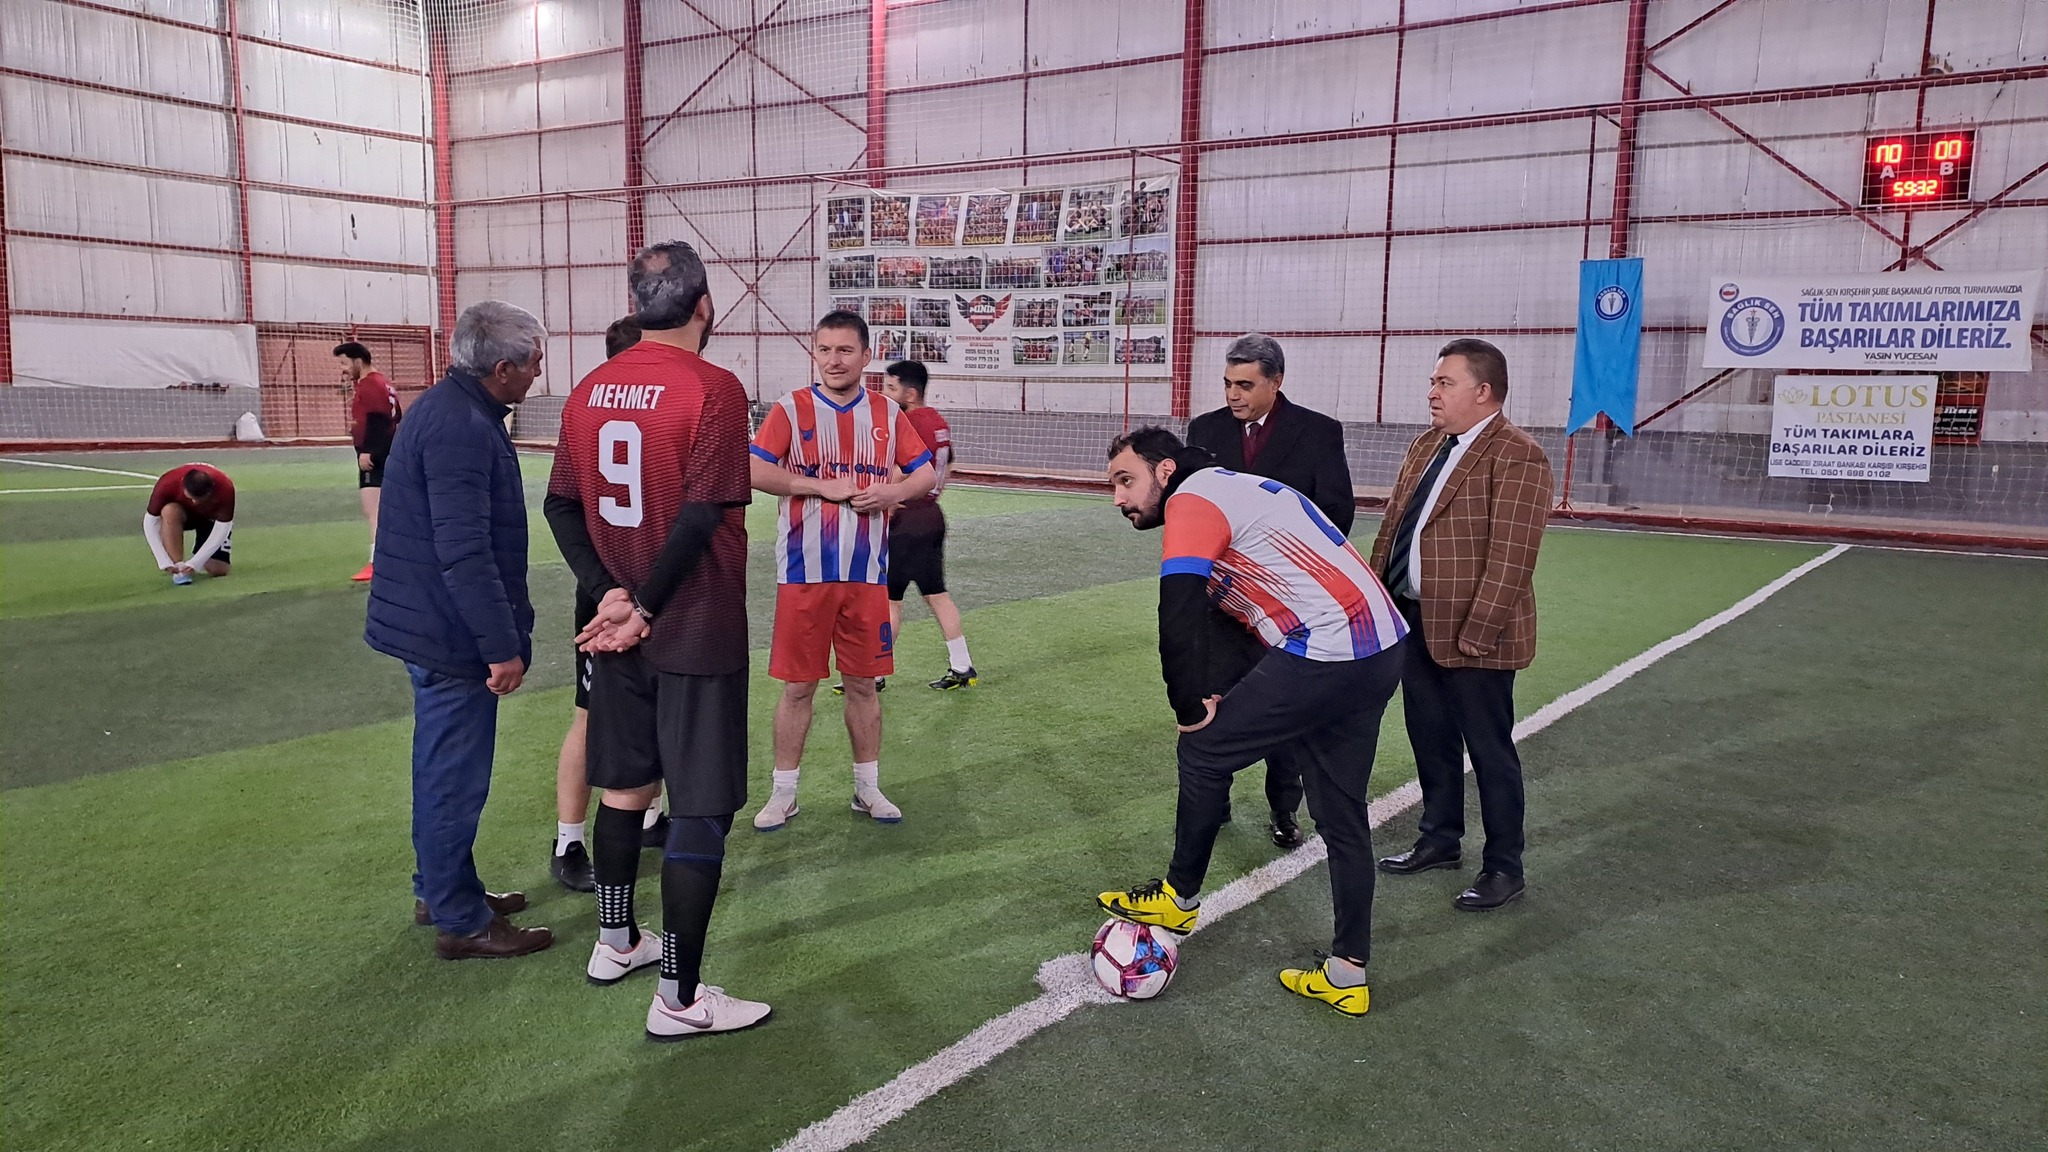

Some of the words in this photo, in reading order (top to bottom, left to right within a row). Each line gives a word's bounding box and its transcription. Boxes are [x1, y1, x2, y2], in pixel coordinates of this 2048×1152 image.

[1935, 140, 1962, 160] 00
[1880, 165, 1895, 179] A
[1940, 162, 1954, 175] B
[1893, 180, 1938, 197] 59:32
[1840, 286, 1871, 297] KIRŞEHİR
[1872, 287, 1890, 297] ŞUBE
[1891, 286, 1933, 297] BAŞKANLIĞI
[1934, 286, 1962, 295] FUTBOL
[1963, 285, 2023, 295] TURNUVAMIZDA
[1798, 298, 1843, 322] TÜM
[1848, 300, 2021, 322] TAKIMLARIMIZA
[1800, 328, 1916, 354] BAŞARILAR
[1920, 323, 2012, 349] DİLERİZ.
[587, 383, 665, 410] MEHMET
[1810, 384, 1928, 408] LOTUS
[1816, 410, 1906, 425] PASTANESİ
[1784, 424, 1816, 438] TÜM
[1821, 428, 1914, 441] TAKIMLARA
[1772, 443, 1858, 456] BAŞARILAR
[1862, 442, 1926, 457] DİLERİZ
[598, 420, 643, 528] 9
[829, 462, 850, 473] YK
[879, 621, 893, 651] 9
